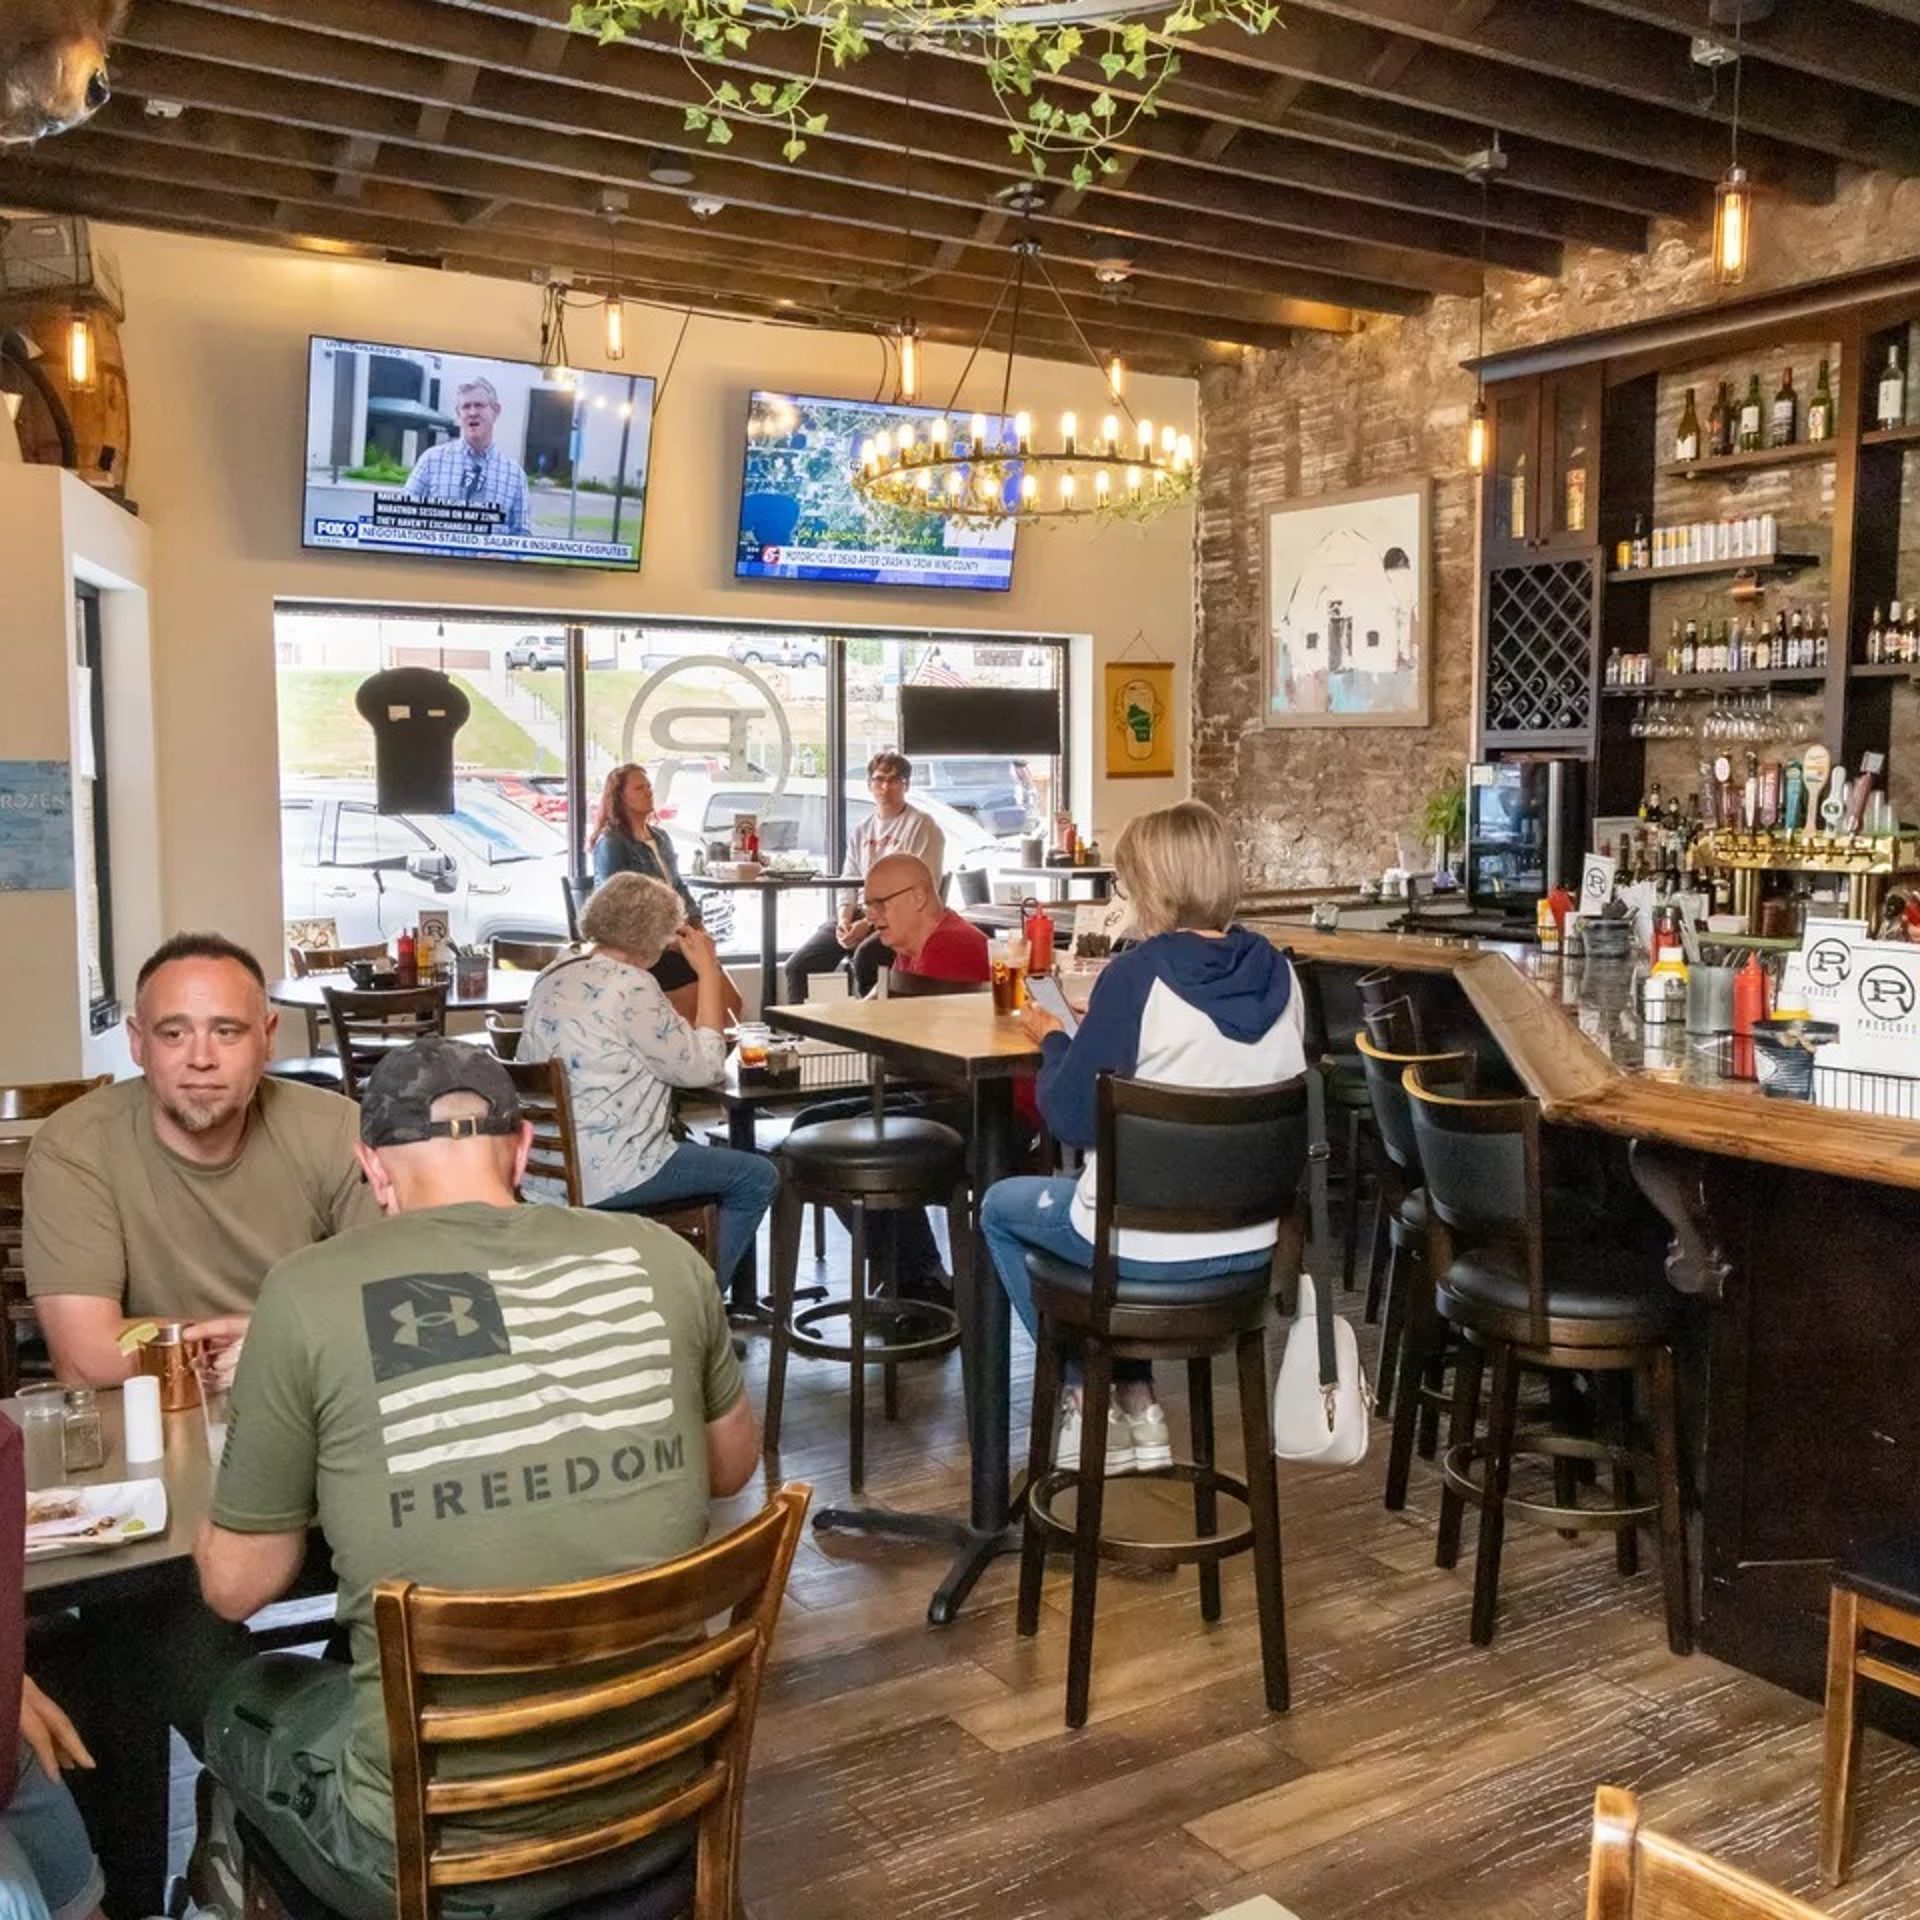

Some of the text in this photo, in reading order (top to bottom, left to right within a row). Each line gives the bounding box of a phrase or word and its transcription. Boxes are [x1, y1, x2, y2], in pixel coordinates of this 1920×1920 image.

[363, 527, 437, 542] NEGOTIATIONS
[483, 536, 521, 548] SALARY
[521, 539, 529, 549] &
[529, 540, 584, 554] INSURANCE
[585, 545, 629, 557] DISPUTES
[785, 550, 837, 563] MOTORCYCLIST
[838, 553, 858, 563] DEAD
[859, 555, 880, 566] AFTER
[881, 556, 905, 567] CRASH
[952, 561, 979, 571] COUNTY
[389, 1433, 685, 1528] FREEDOM
